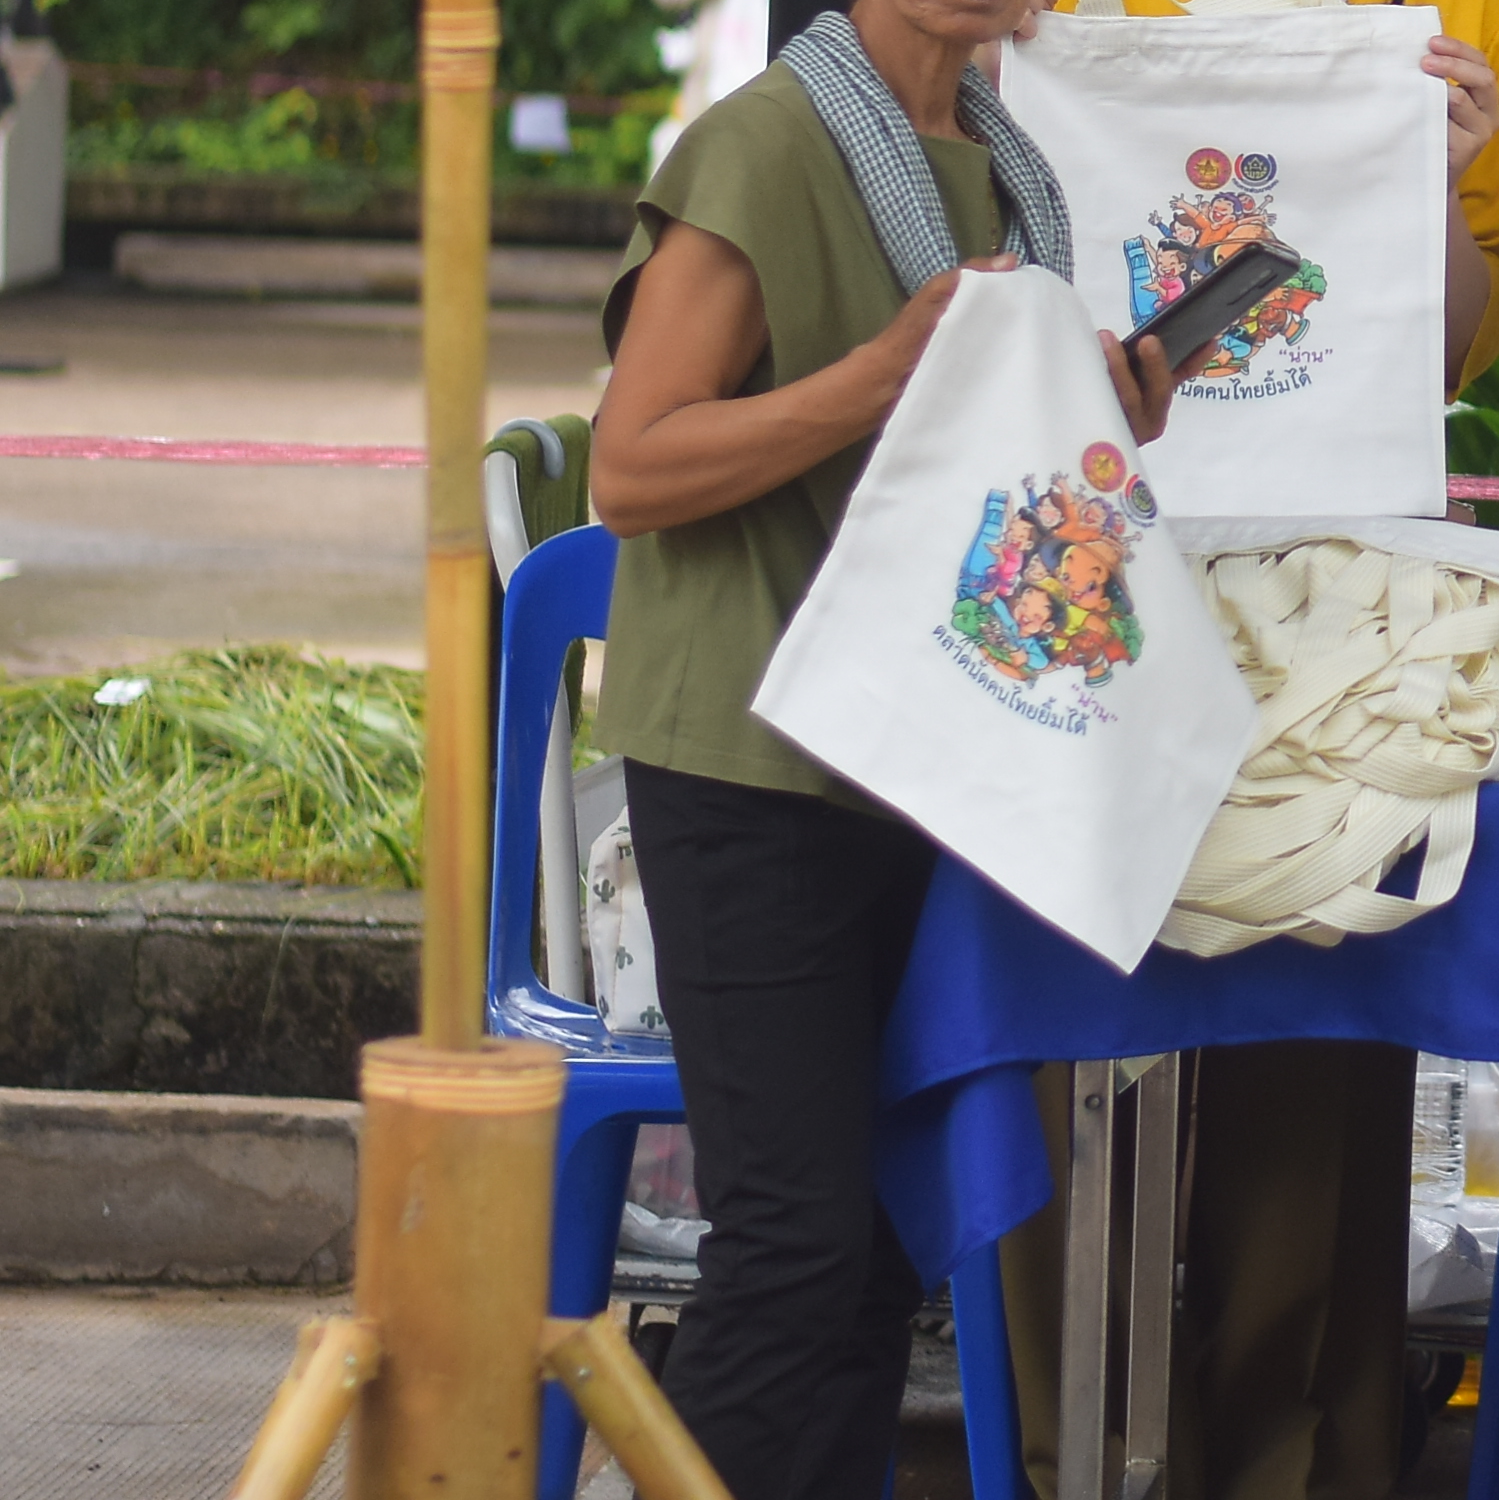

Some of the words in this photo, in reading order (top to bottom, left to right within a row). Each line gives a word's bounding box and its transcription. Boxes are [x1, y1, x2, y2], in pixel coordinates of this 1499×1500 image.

[931, 624, 1089, 737] ตลาดนัดคนไทยยิ้มได้
